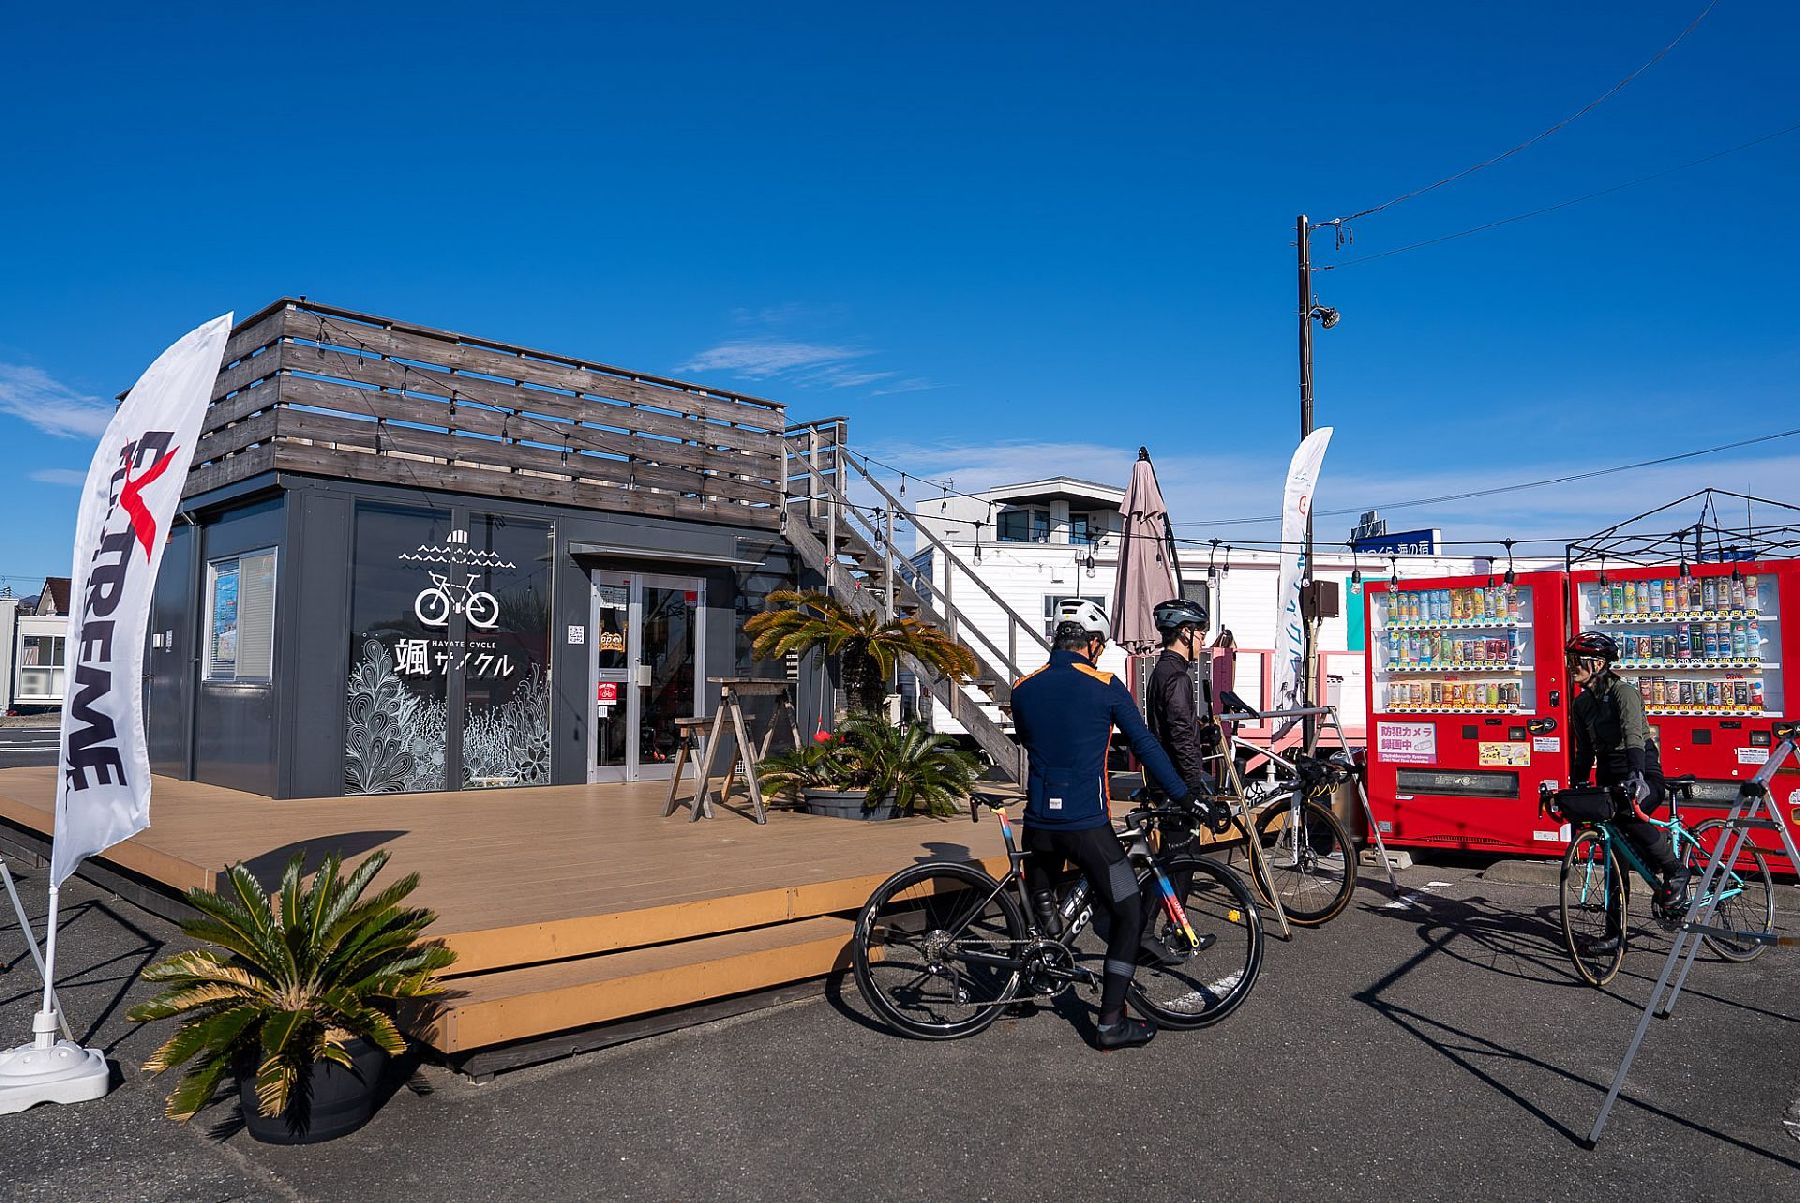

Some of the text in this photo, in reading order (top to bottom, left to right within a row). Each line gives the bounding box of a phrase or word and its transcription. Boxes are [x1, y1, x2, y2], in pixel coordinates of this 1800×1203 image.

[432, 640, 496, 649] HAYATE CYCLE
[1380, 726, 1432, 737] 防犯カメラ
[1380, 738, 1412, 751] 録画中
